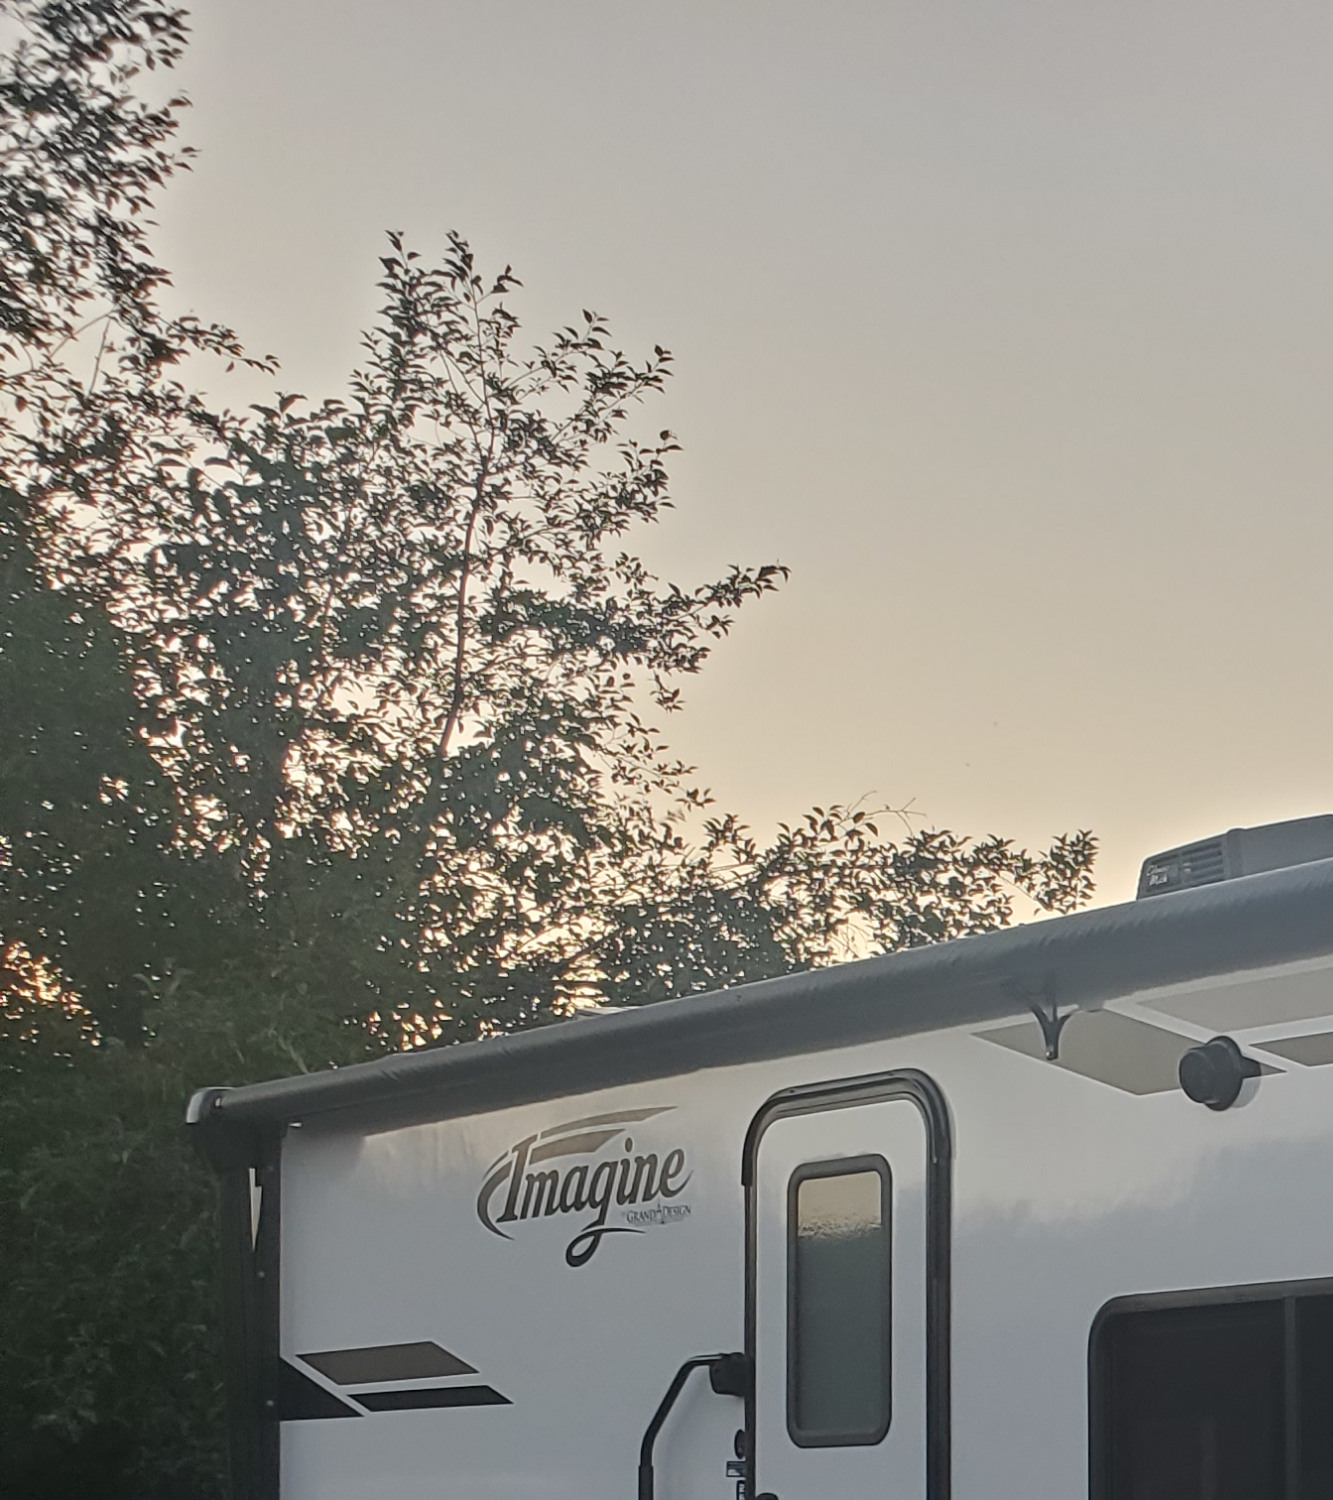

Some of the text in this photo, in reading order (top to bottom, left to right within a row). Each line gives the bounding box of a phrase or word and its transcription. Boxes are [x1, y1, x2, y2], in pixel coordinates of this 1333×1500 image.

[496, 1134, 694, 1268] Imagine
[626, 1208, 657, 1224] GRAND
[662, 1205, 692, 1218] DESIGN
